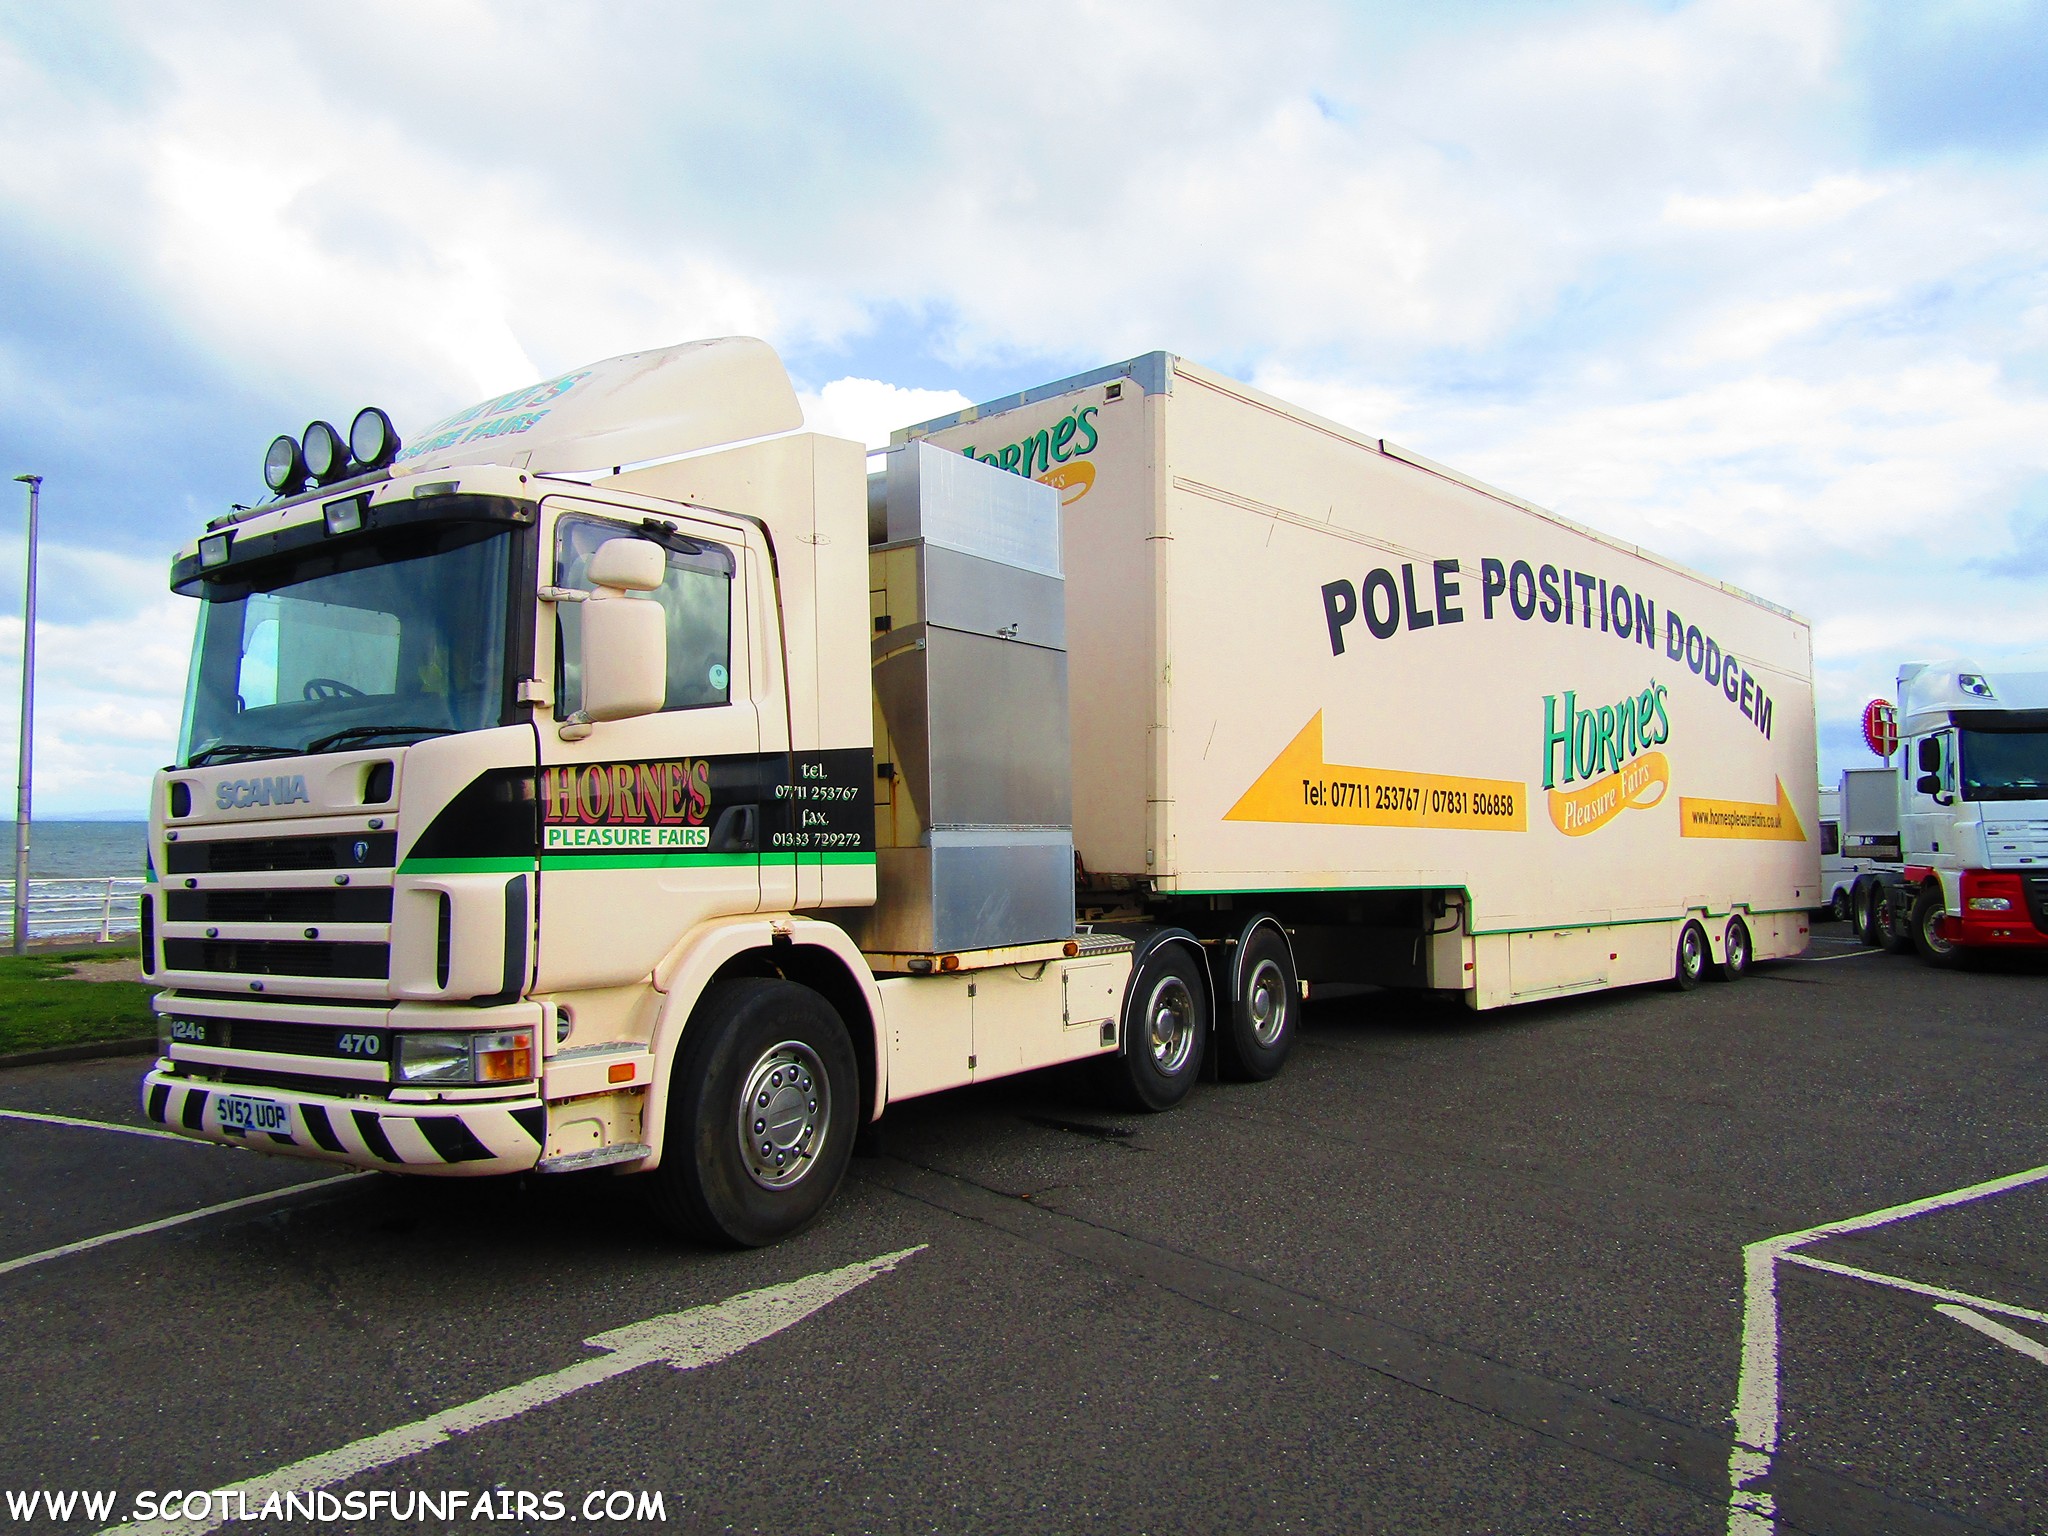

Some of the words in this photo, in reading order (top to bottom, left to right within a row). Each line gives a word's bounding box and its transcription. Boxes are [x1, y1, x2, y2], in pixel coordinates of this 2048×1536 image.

[1321, 558, 1463, 656] POLE
[1481, 558, 1655, 649] POSITION
[1666, 609, 1773, 741] DODGEM
[215, 775, 310, 809] SCANIA
[543, 758, 711, 826] HORNE'S
[811, 786, 858, 801] 253767
[1302, 780, 1327, 806] Tel:
[1331, 781, 1370, 808] 07711
[1375, 785, 1420, 811] 253767
[1432, 790, 1468, 814] 07831
[1472, 794, 1514, 816] 506858
[1564, 787, 1616, 830] Pleasure
[1620, 762, 1649, 799] Fairs
[802, 808, 829, 828] fax.
[549, 828, 651, 846] PLEASURE
[658, 826, 706, 845] FAIRS
[812, 833, 861, 847] 729272
[339, 1034, 380, 1054] 470
[217, 1098, 254, 1126] SV52
[255, 1104, 286, 1128] UOP
